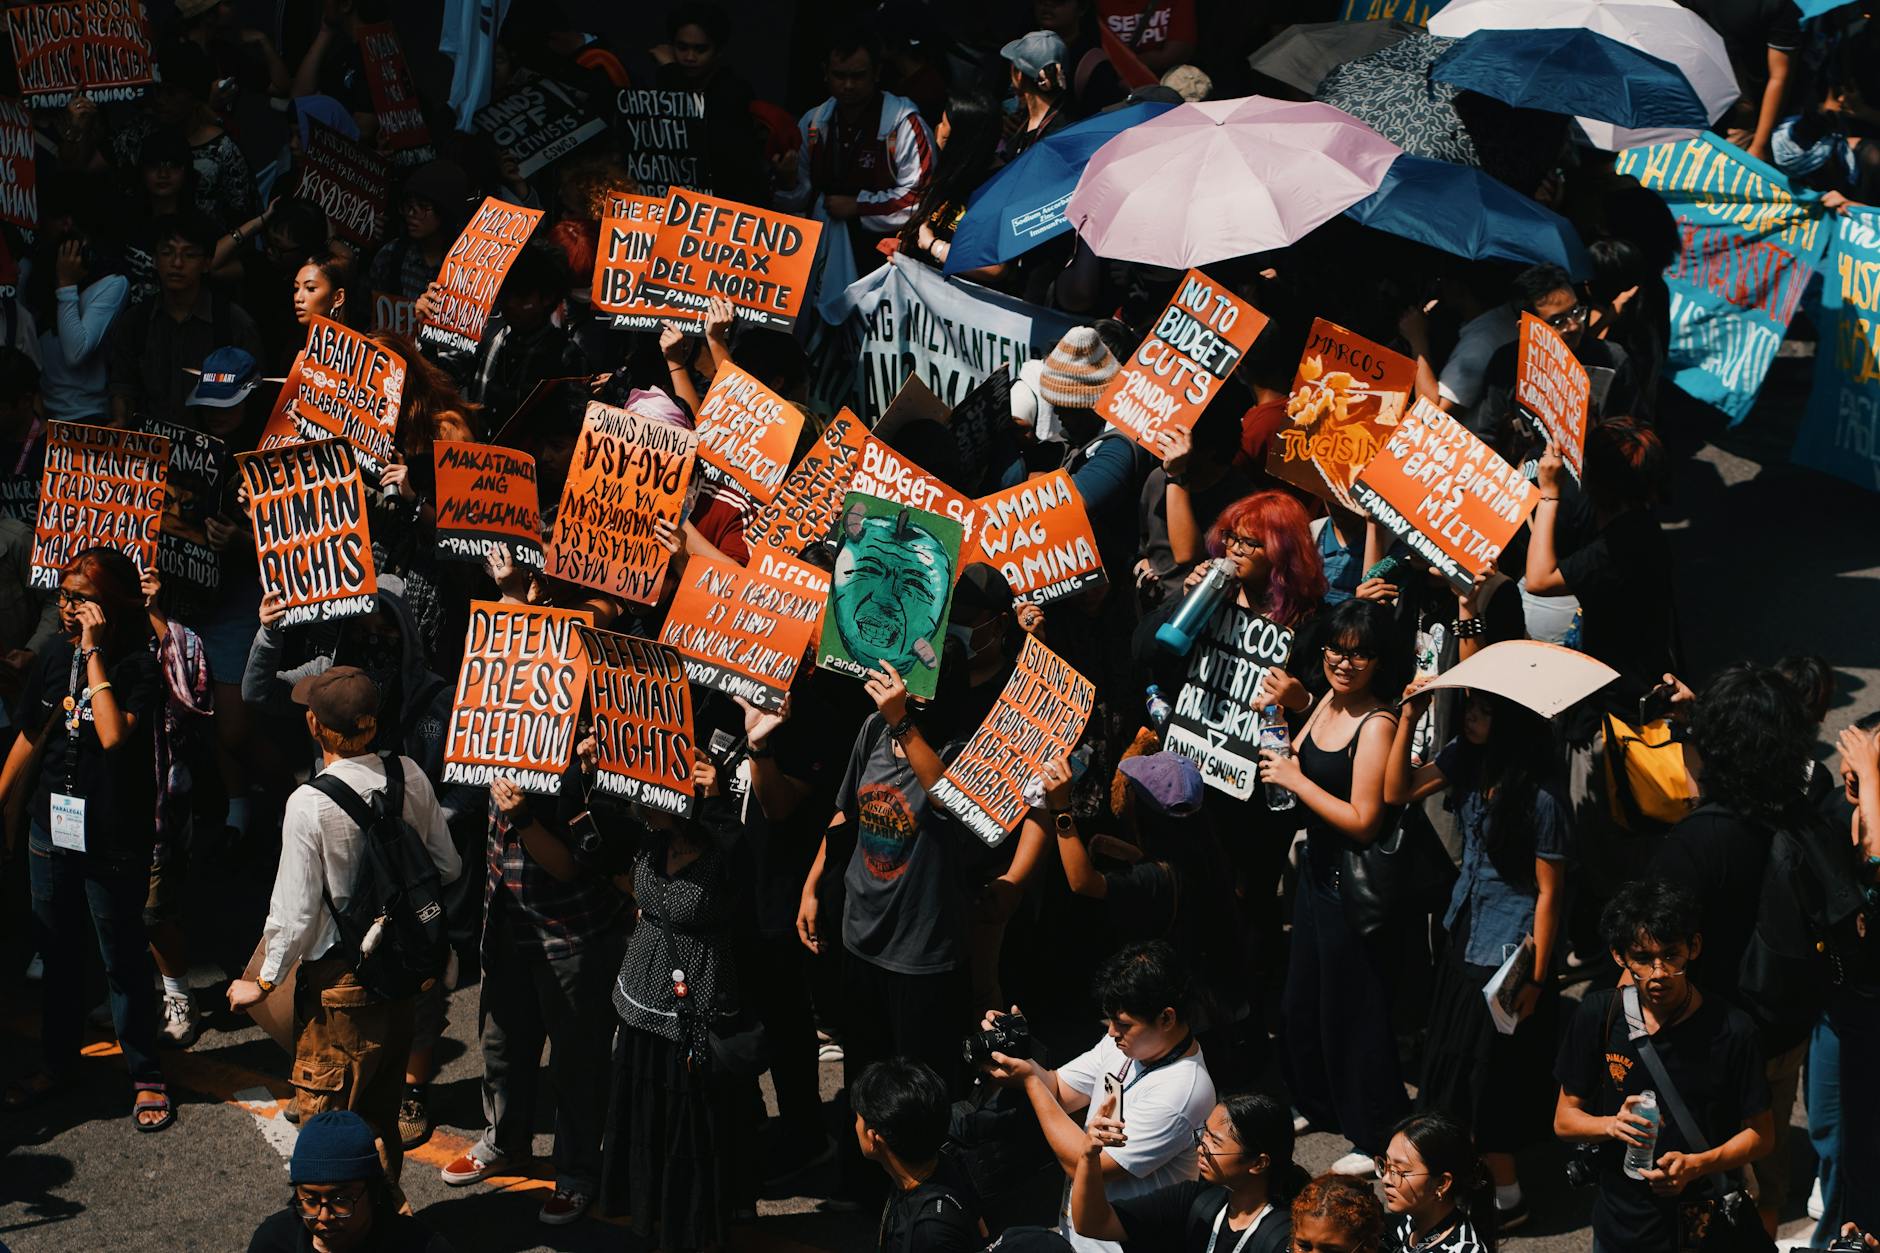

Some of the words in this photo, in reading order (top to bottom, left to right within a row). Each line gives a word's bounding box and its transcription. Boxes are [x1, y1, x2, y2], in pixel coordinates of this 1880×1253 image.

[7, 4, 83, 66] MARCOS
[31, 93, 71, 109] PAND
[476, 86, 545, 132] HANDS
[617, 89, 705, 119] CHRISTIAN
[494, 105, 546, 146] OFF
[627, 118, 688, 151] YOUTH
[627, 152, 698, 184] AGAINST
[473, 204, 538, 244] MARCOS
[611, 198, 642, 222] THE
[647, 203, 665, 224] PE
[665, 193, 804, 257] DEFEND
[1013, 211, 1041, 227] Sodium
[1040, 211, 1055, 222] Zinc
[449, 232, 518, 273] DUTERTE
[608, 227, 657, 264] MIN
[678, 233, 771, 276] DUPAX
[443, 261, 503, 305] SINGILIN
[651, 256, 696, 286] DEL
[706, 269, 793, 310] NORTE
[664, 287, 712, 307] PANDA
[734, 305, 768, 324] NING
[1178, 276, 1212, 313] NO
[1209, 294, 1239, 333] TO
[420, 324, 454, 345] PANDAY
[614, 314, 659, 328] PANDAY
[1156, 307, 1240, 375] BUDGET
[305, 323, 390, 394] ABANTE
[1137, 339, 1212, 405] CUTS
[1309, 333, 1385, 381] MARCOS
[299, 382, 349, 422] PALABAN
[336, 378, 388, 423] BABAE
[1109, 391, 1162, 443] SINING
[145, 418, 187, 442] KAHIT
[301, 416, 335, 440] PANDA
[352, 445, 377, 473] NING
[593, 408, 638, 444] SINING
[637, 423, 689, 457] PANDAY
[168, 443, 220, 488] ANAS
[243, 438, 358, 500] DEFEND
[583, 430, 688, 496] PAG-ASA
[1397, 418, 1424, 447] SA
[1421, 433, 1458, 471] MGA
[1455, 462, 1522, 524] BIKTIMA
[1411, 397, 1486, 466] HUSTISYA
[1483, 453, 1531, 501] PARA
[471, 475, 509, 495] ANG
[586, 474, 629, 506] MAY
[744, 457, 823, 548] HUSTISYA
[823, 419, 852, 450] SA
[767, 522, 793, 549] GA
[785, 443, 859, 523] BIKTIMA
[1386, 436, 1409, 459] NG
[1402, 451, 1465, 511] BATAS
[254, 480, 361, 554] HUMAN
[634, 488, 660, 512] NA
[796, 486, 837, 541] CRIM
[560, 517, 584, 550] SA
[979, 519, 1047, 560] WAG
[1360, 488, 1412, 536] PANDAY
[1407, 529, 1459, 578] SINING
[30, 564, 60, 589] PAN
[260, 532, 366, 606] RIGHTS
[515, 544, 546, 571] SININ
[616, 560, 667, 600] ANG
[695, 565, 738, 600] ANG
[1032, 575, 1083, 605] SINING
[285, 607, 320, 628] NDAY
[321, 594, 375, 621] SINING
[705, 601, 731, 626] AY
[730, 608, 778, 638] HINDI
[466, 608, 587, 665] DEFEND
[576, 628, 684, 684] DEFEND
[456, 656, 577, 715] PRESS
[683, 660, 719, 685] ANDAY
[718, 673, 767, 705] SINING
[823, 654, 868, 677] panday
[1020, 636, 1071, 696] ISULONG
[1068, 670, 1094, 715] ANG
[591, 668, 685, 729] HUMAN
[1002, 666, 1087, 747] MILITANTENG
[446, 706, 576, 769] FREEDOM
[594, 712, 691, 783] RIGHTS
[986, 697, 1048, 761] TRADISYON
[443, 761, 506, 785] PANDAY
[504, 767, 562, 794] SINING
[958, 724, 1041, 798] KABATAAN
[1205, 756, 1248, 790] SINING
[52, 804, 83, 816] PARALEGAL
[596, 769, 640, 798] PANDAY
[640, 785, 688, 814] SINING
[928, 776, 973, 818] PANDAY
[961, 806, 1005, 844] SINING
[946, 754, 1025, 826] MAKABAYAN
